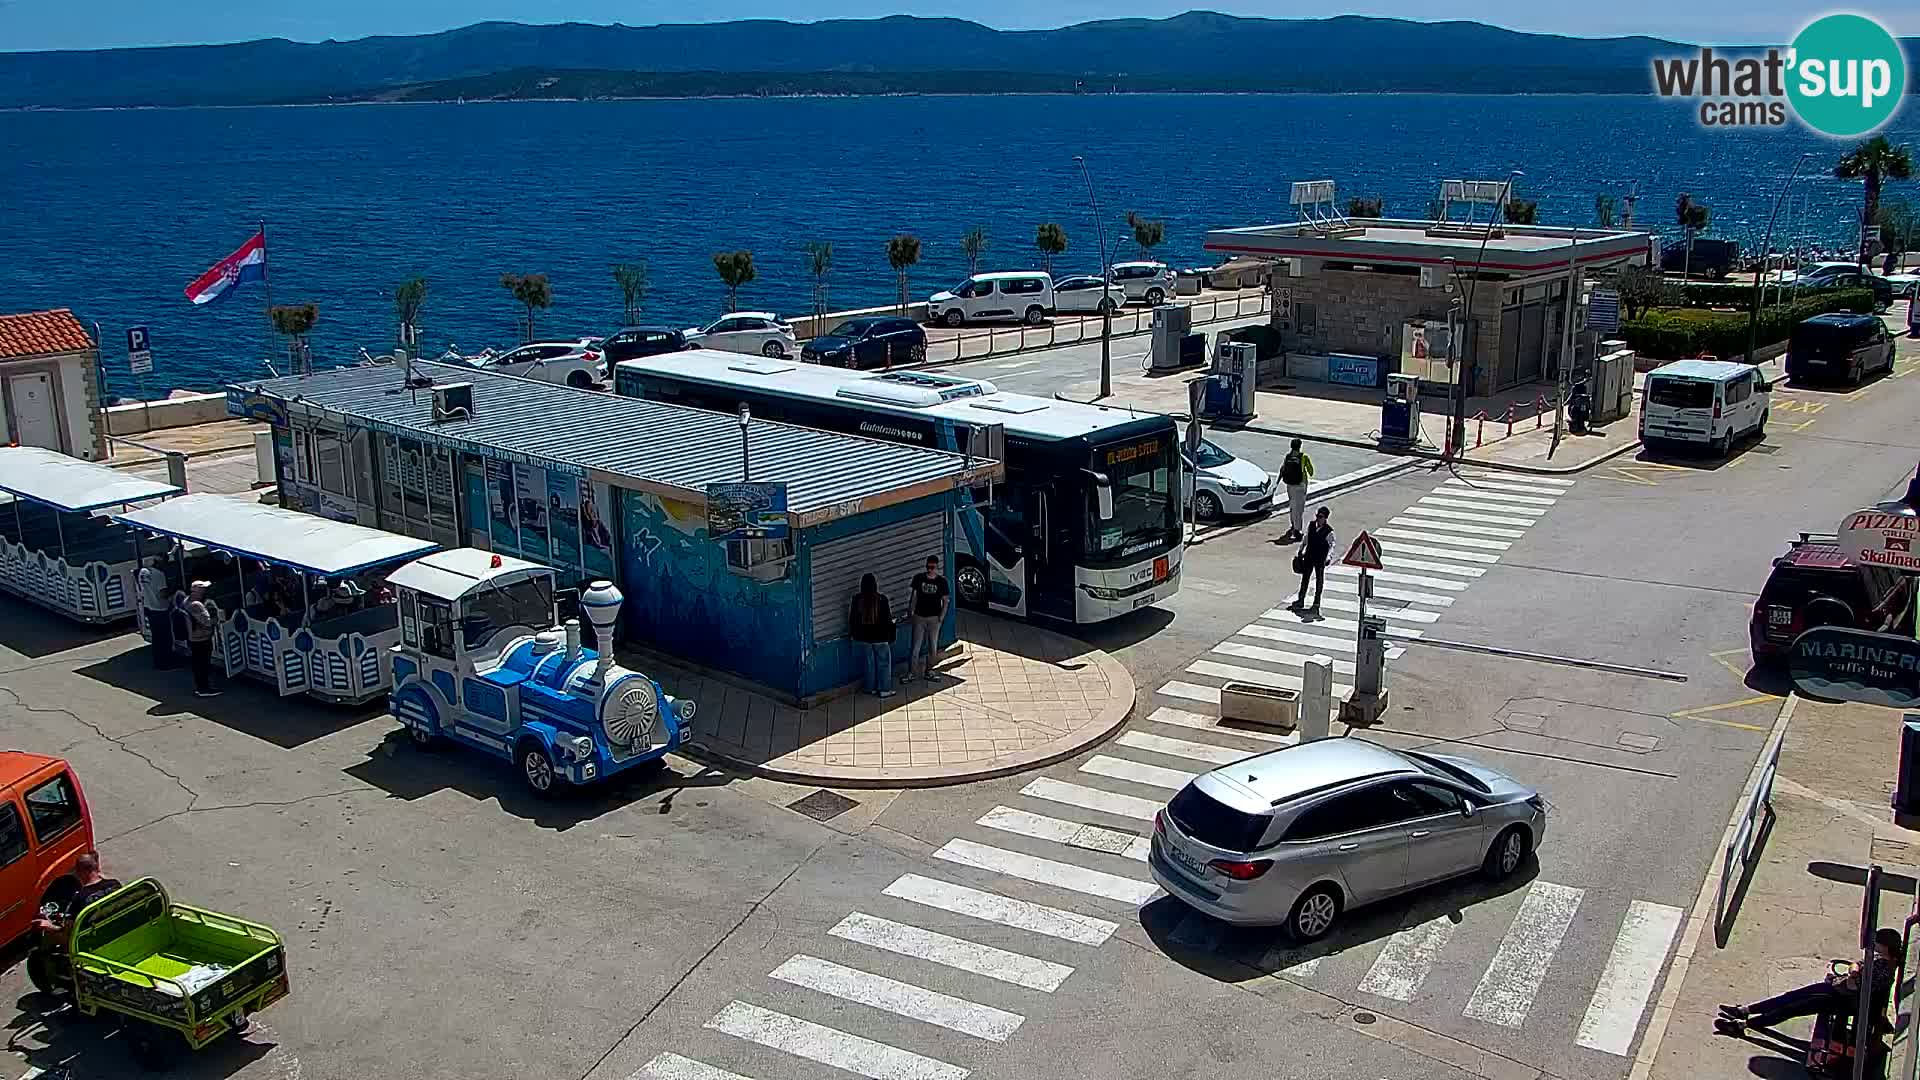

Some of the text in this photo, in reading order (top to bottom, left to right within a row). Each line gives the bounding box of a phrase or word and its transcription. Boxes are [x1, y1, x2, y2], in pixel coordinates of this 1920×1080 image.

[132, 331, 143, 348] P
[479, 446, 494, 457] BUS
[495, 449, 527, 464] STATION
[528, 456, 555, 470] TICKET
[556, 463, 583, 476] OFFICE
[1848, 514, 1920, 532] PIZZE
[1882, 529, 1916, 539] GRILL
[1829, 662, 1896, 678] caffe bar
